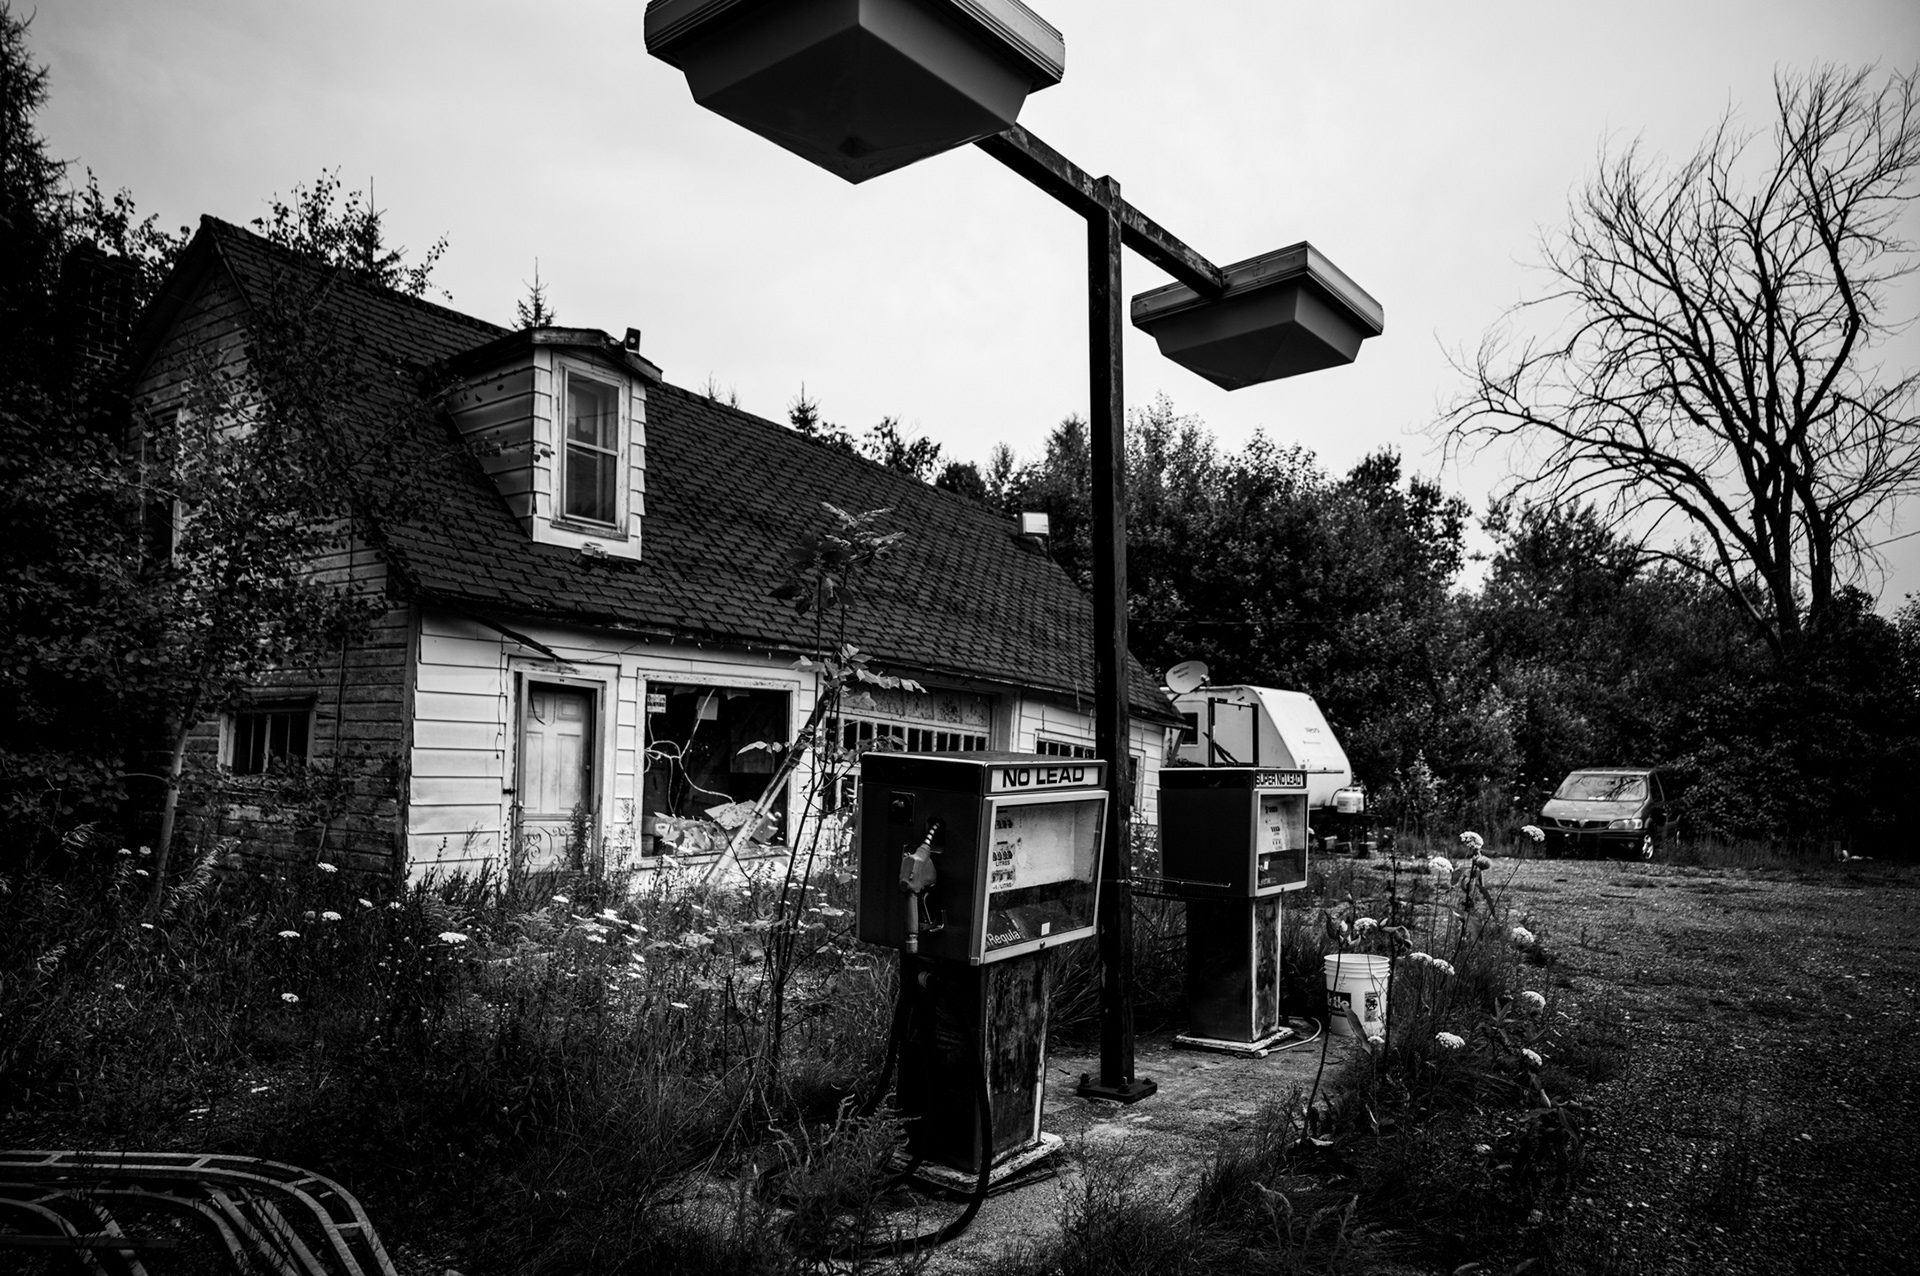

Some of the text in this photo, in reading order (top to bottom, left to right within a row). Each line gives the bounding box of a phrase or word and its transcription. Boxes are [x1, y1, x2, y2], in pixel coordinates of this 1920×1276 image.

[1002, 766, 1085, 788] NO LEAD
[1256, 773, 1301, 785] SUPER NO LEAD
